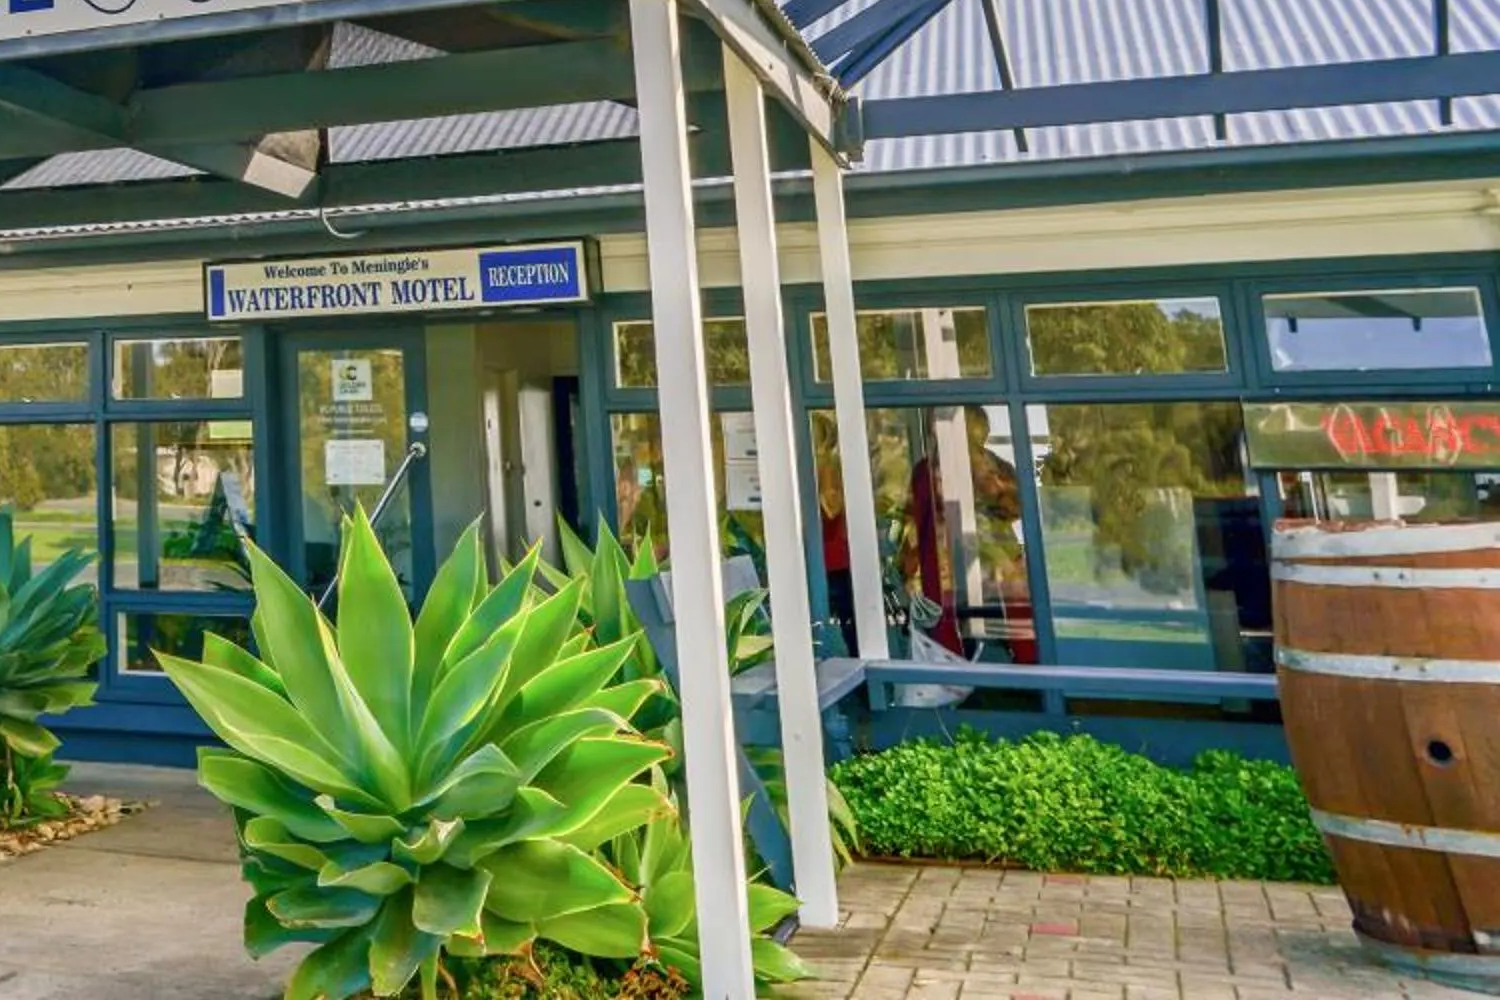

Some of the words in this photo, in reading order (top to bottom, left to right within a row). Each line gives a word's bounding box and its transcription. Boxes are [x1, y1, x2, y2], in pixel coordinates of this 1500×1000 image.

[264, 265, 326, 279] Welcome
[330, 261, 349, 275] To
[351, 256, 429, 274] Meningie's
[488, 261, 570, 288] RECEPTION
[227, 281, 382, 313] WATERFRONT
[390, 276, 475, 306] MOTEL
